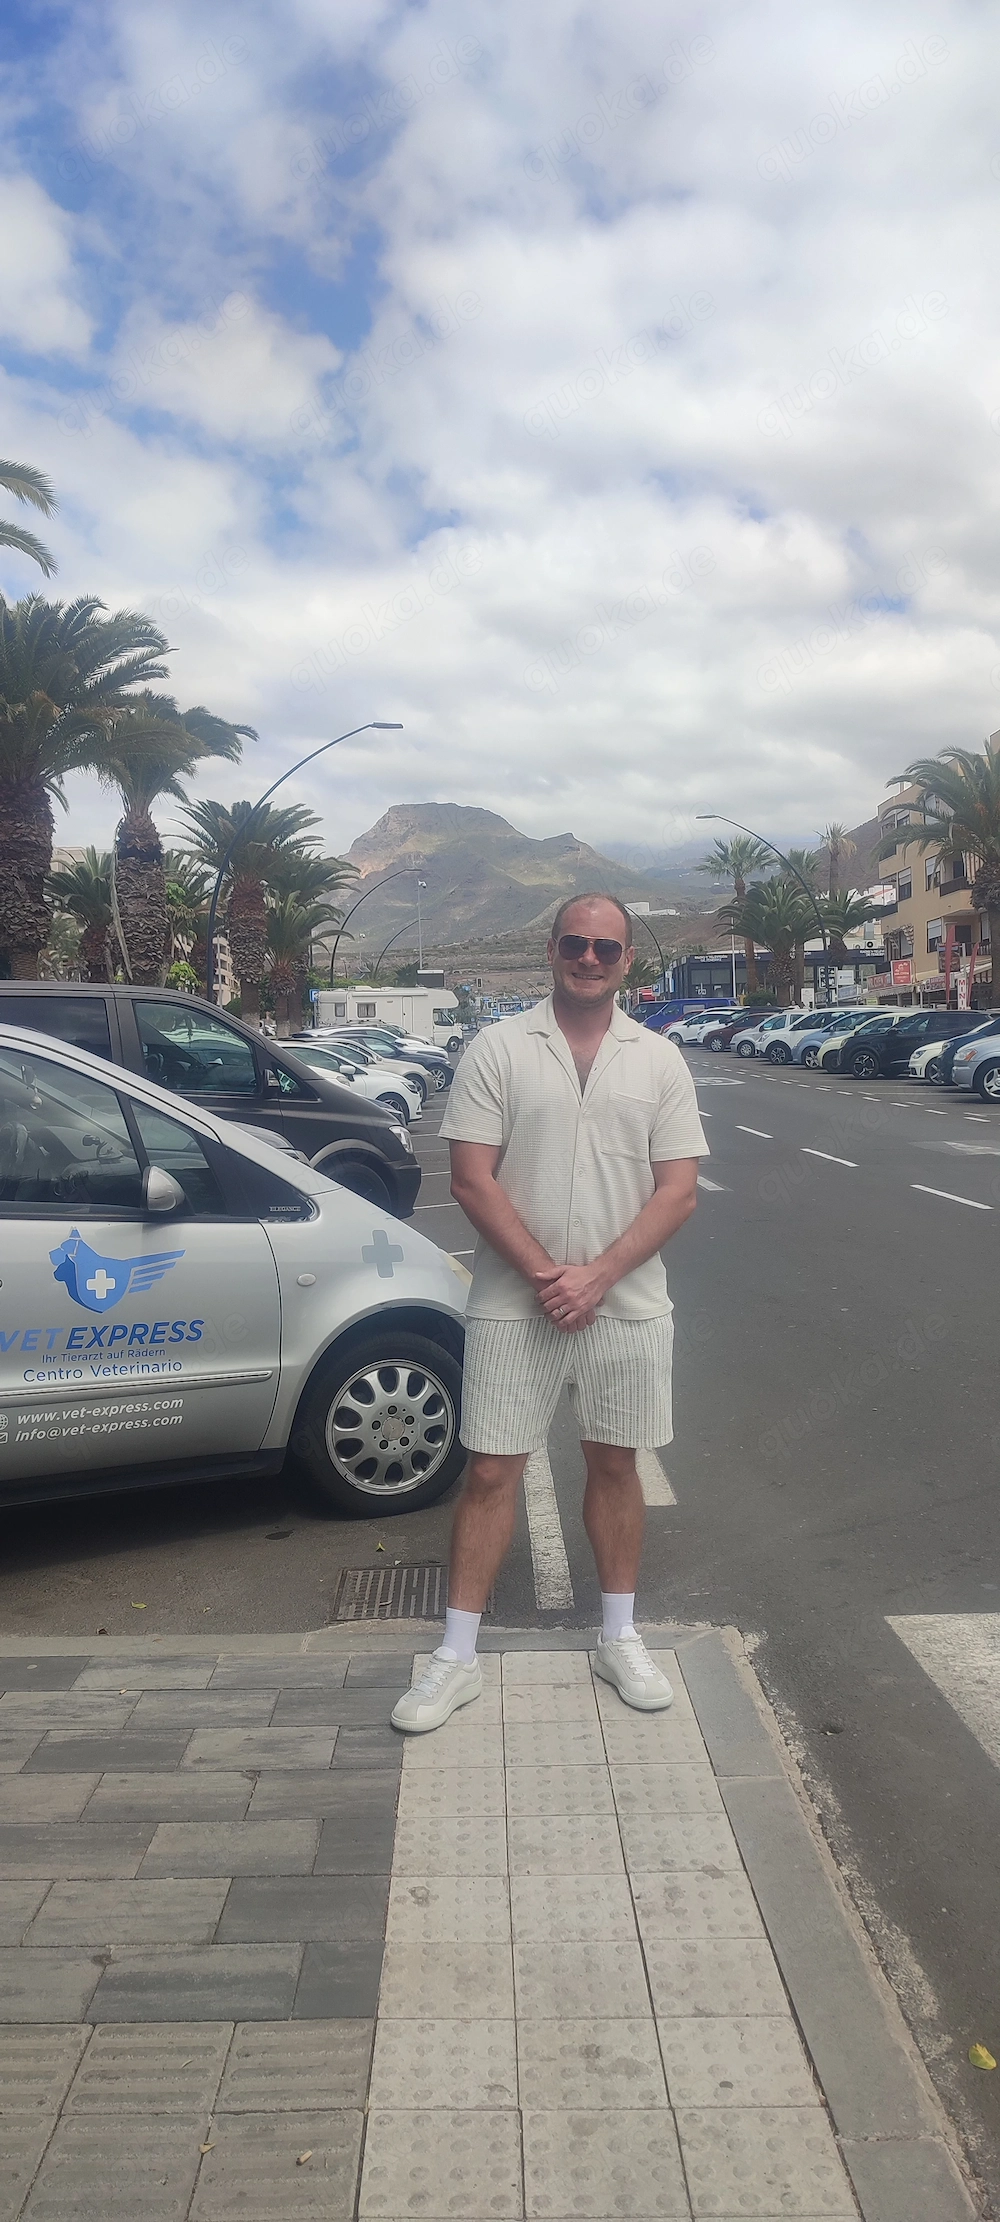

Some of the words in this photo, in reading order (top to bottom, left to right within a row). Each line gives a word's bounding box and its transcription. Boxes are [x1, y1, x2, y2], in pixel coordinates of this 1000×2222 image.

[0, 1327, 63, 1351] VET
[66, 1319, 205, 1349] EXPRESS
[42, 1354, 58, 1363] Ihr
[61, 1351, 103, 1362] Tierarzt
[107, 1350, 125, 1360] auf
[128, 1348, 166, 1358] Rädern
[23, 1367, 83, 1382] Centro
[91, 1359, 182, 1378] Veterinario
[17, 1397, 184, 1425] www.vet-express.com
[15, 1414, 183, 1441] info@vet-express.com
